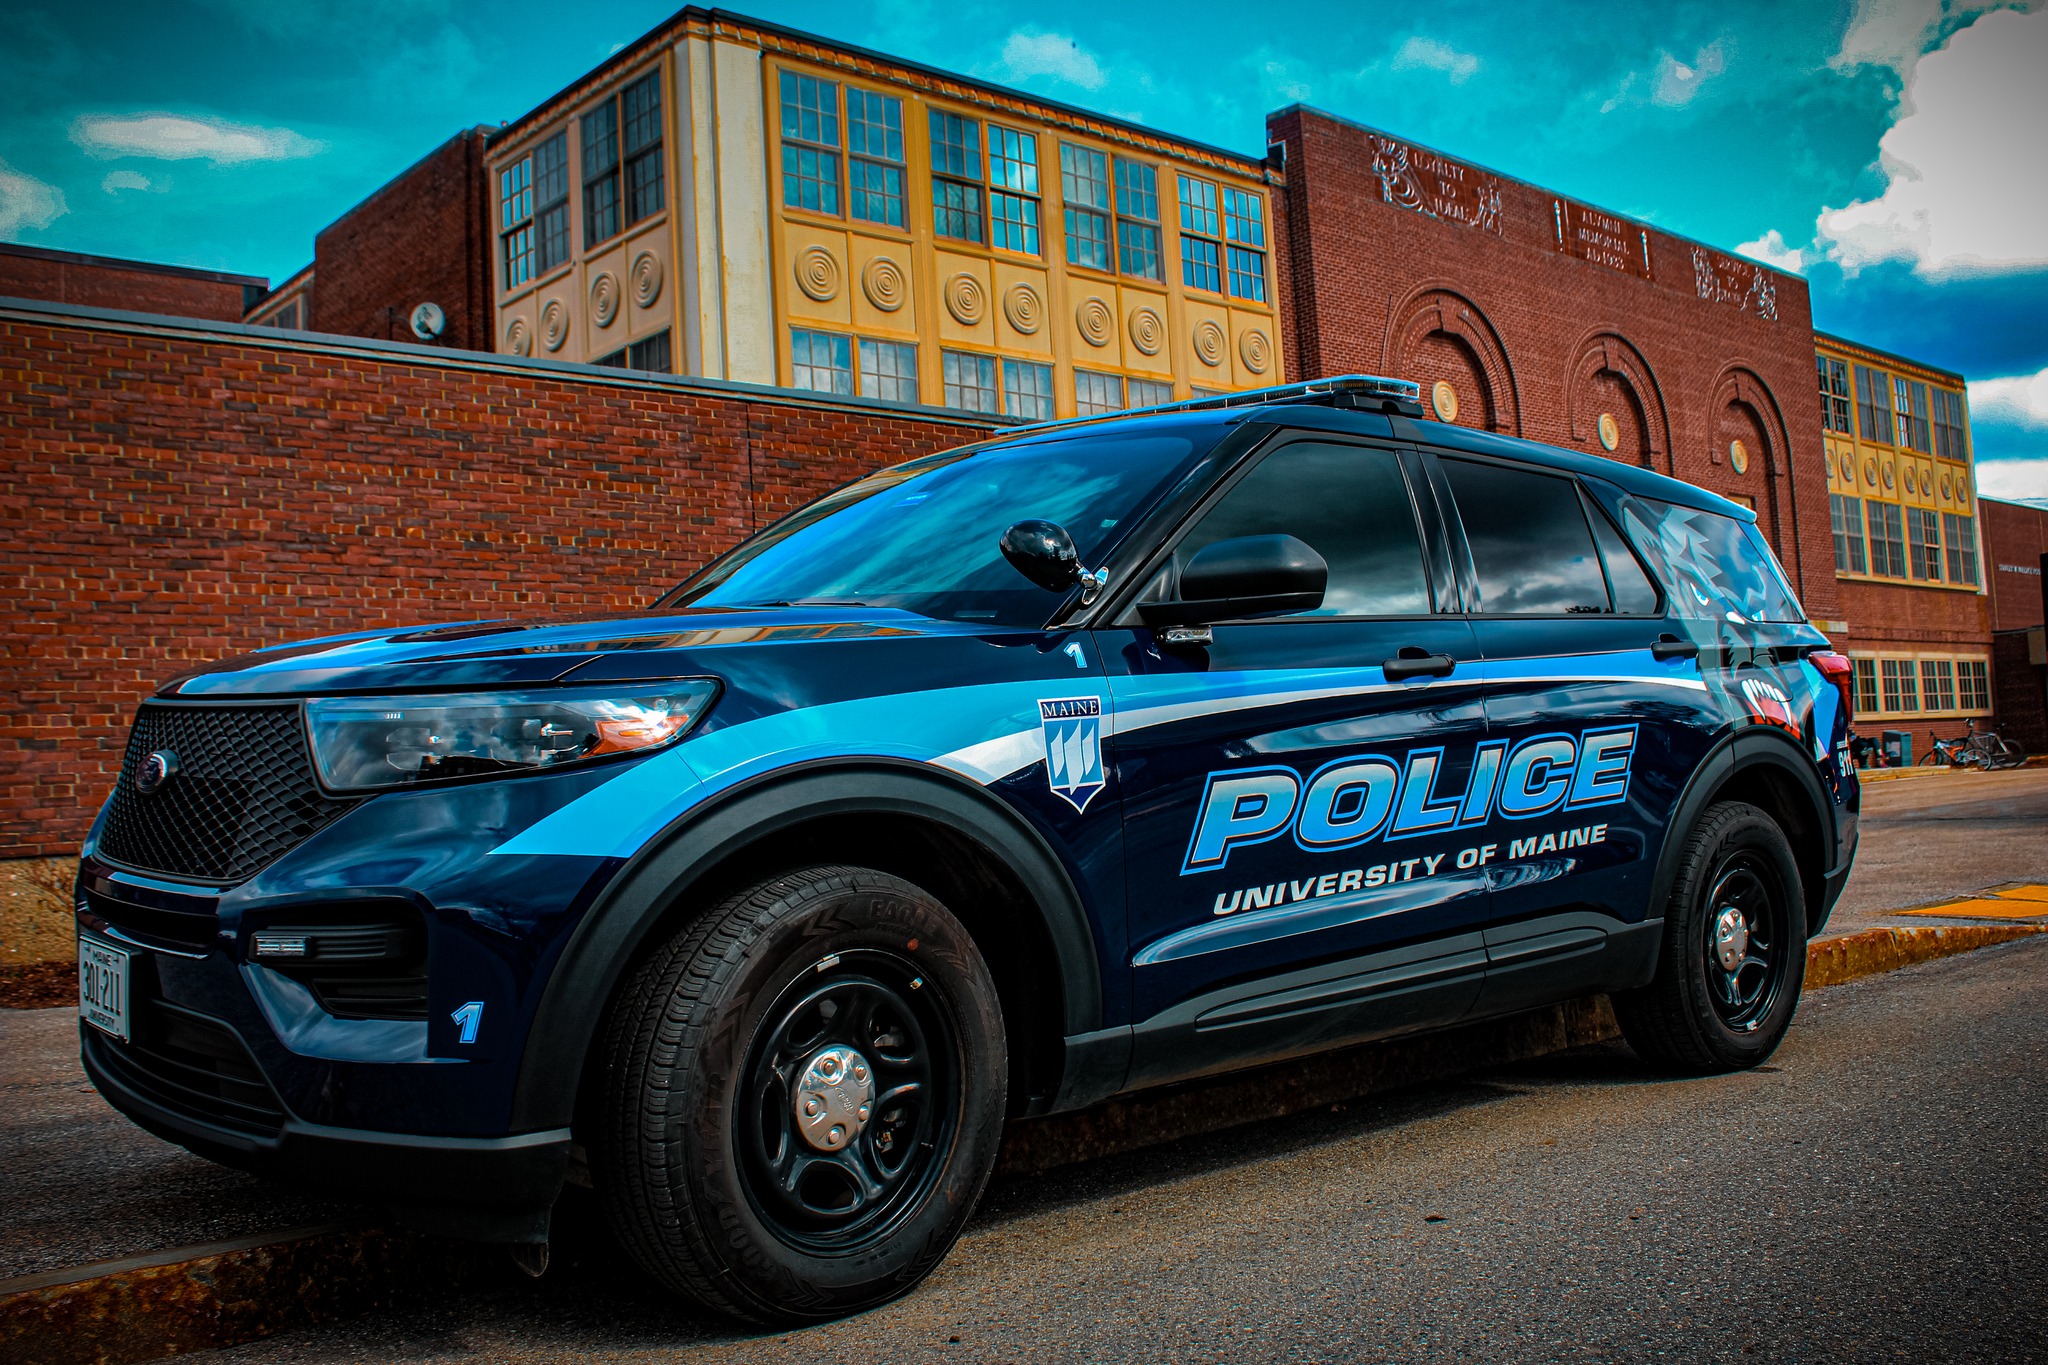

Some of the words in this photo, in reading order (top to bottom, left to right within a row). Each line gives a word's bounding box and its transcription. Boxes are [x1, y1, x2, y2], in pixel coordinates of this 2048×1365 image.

[1439, 180, 1456, 199] TO
[1578, 227, 1630, 255] MEMORIAL
[1063, 641, 1088, 669] 1
[1042, 700, 1099, 718] MAINE
[1837, 749, 1854, 778] 911
[1179, 723, 1640, 876] POLICE
[1213, 853, 1446, 916] UNIVERSITY
[1456, 843, 1498, 870] OF
[1508, 823, 1608, 860] MAINE
[450, 1001, 485, 1044] 1
